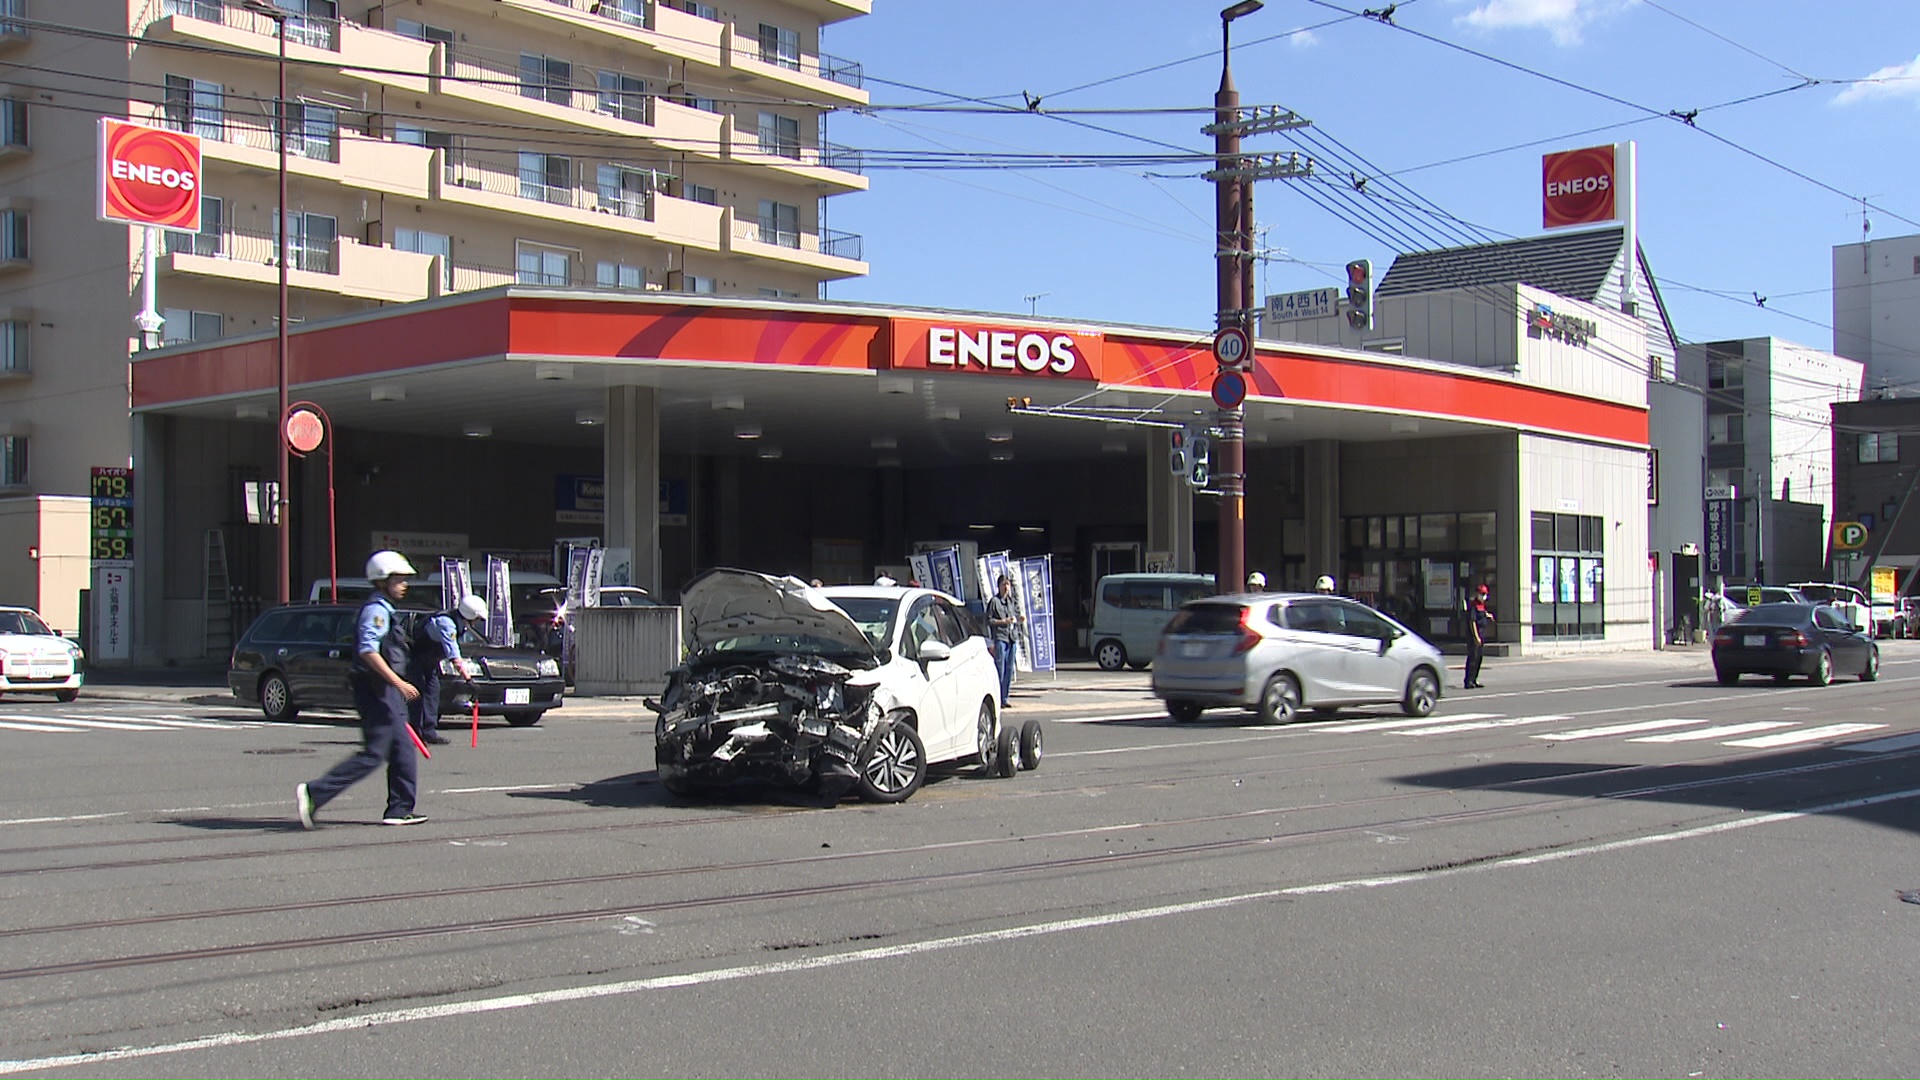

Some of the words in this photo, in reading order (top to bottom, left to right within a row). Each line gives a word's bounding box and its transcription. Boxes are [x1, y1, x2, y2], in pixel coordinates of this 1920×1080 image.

[112, 159, 195, 191] ENEOS
[1546, 175, 1609, 197] ENEOS
[1272, 311, 1292, 320] South
[1294, 309, 1299, 318] 4
[1301, 308, 1319, 317] West
[1320, 306, 1328, 315] 14
[929, 327, 1076, 373] ENEOS
[1220, 339, 1239, 357] 40
[99, 468, 128, 476] ハイオク
[92, 476, 127, 498] 179
[92, 507, 127, 528] 167
[1846, 527, 1860, 544] P
[92, 538, 127, 559] 159
